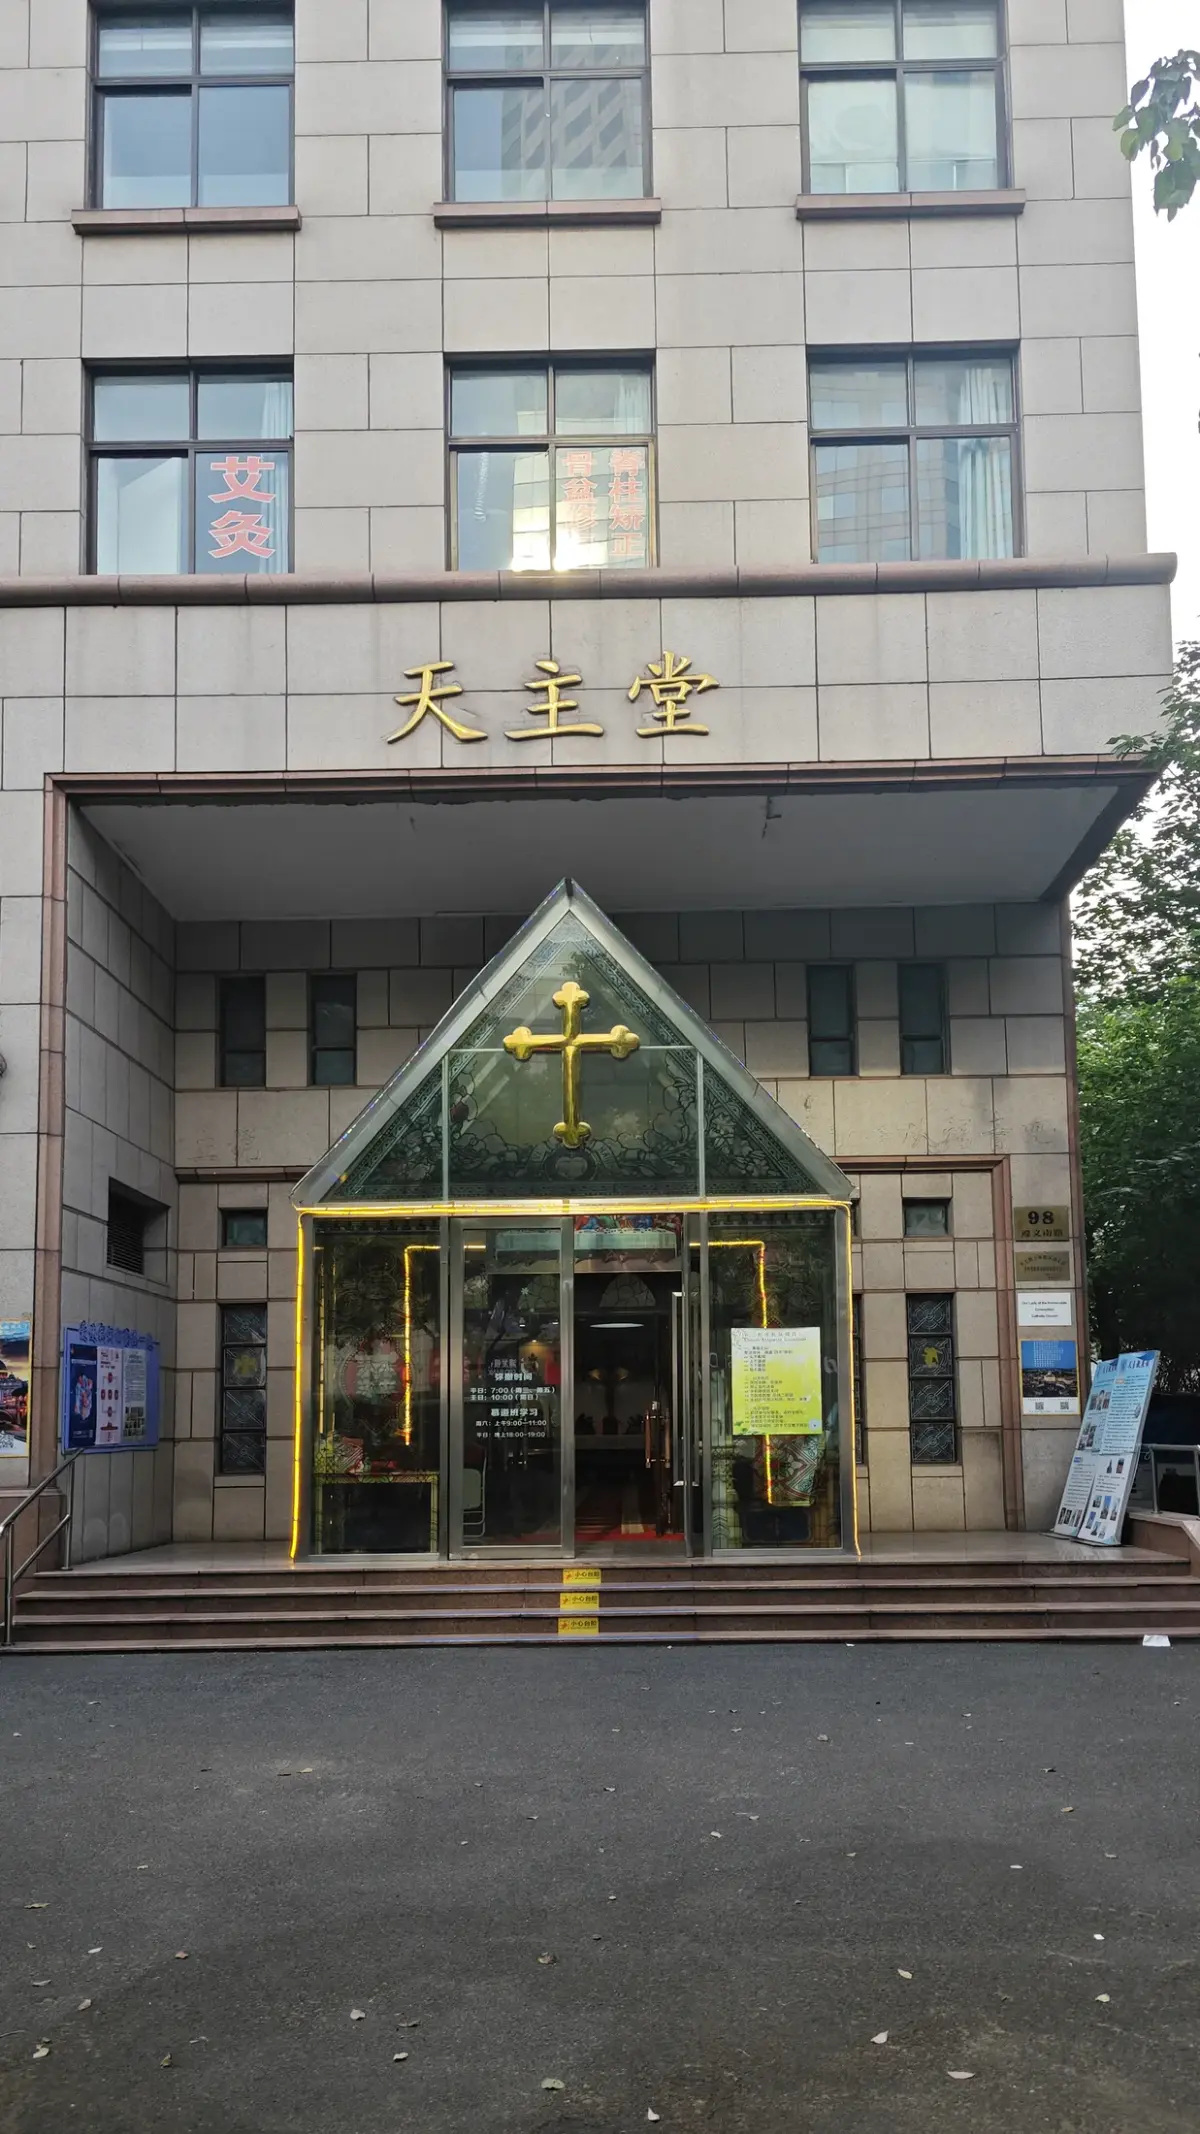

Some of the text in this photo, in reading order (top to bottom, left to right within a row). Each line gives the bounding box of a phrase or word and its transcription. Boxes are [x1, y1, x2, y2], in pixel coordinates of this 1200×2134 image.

[208, 456, 276, 558] 艾灸
[609, 450, 645, 557] 脊柱矫正
[386, 651, 720, 744] 天主堂
[1028, 1211, 1054, 1225] 98
